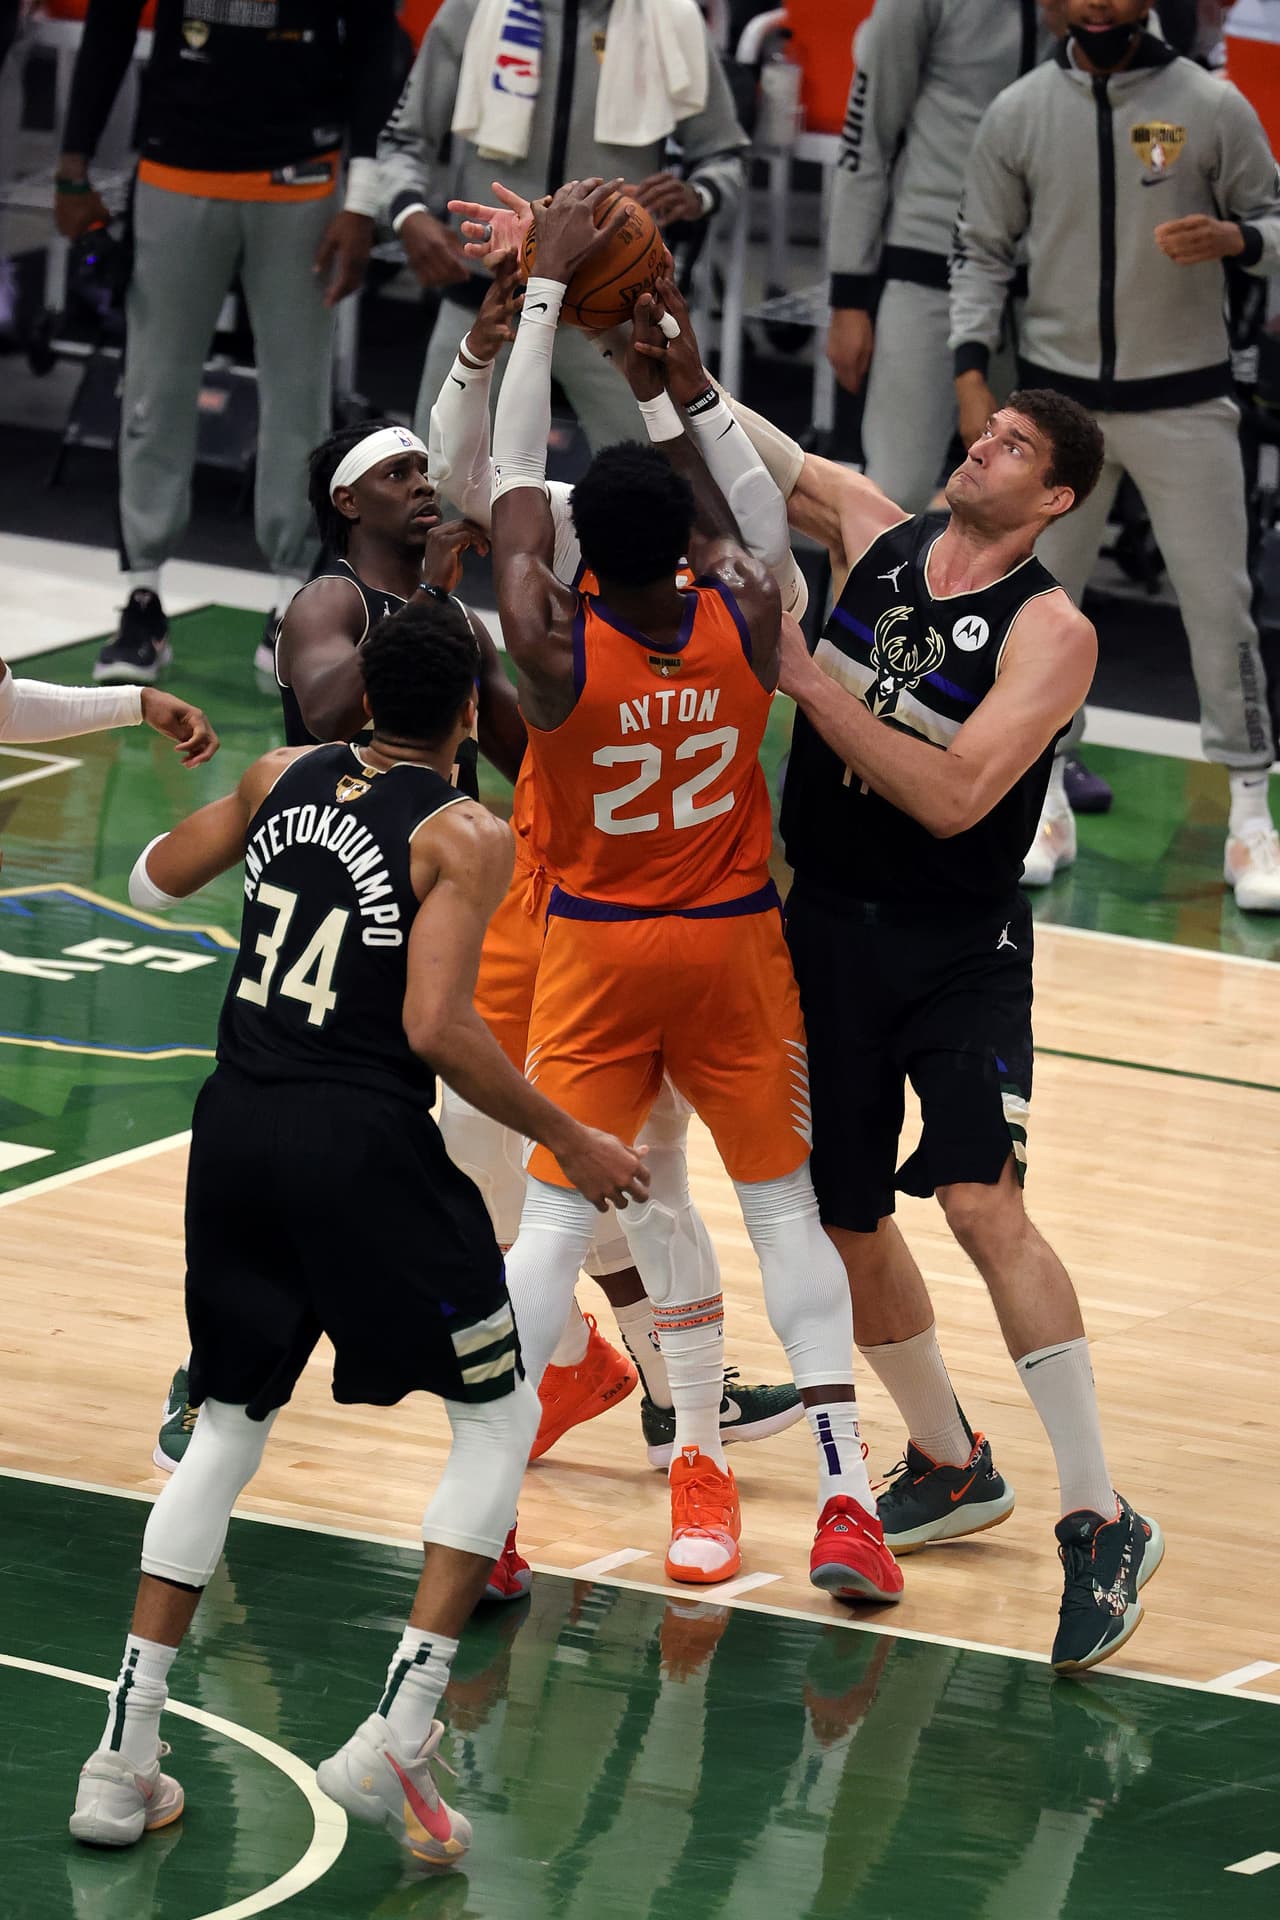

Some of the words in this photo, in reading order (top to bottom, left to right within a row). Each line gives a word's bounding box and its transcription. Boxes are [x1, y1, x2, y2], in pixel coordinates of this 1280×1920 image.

[619, 688, 721, 735] AYTON
[592, 725, 740, 836] 22
[243, 804, 403, 947] ANTETOKOUNMPO
[236, 881, 350, 1027] 34
